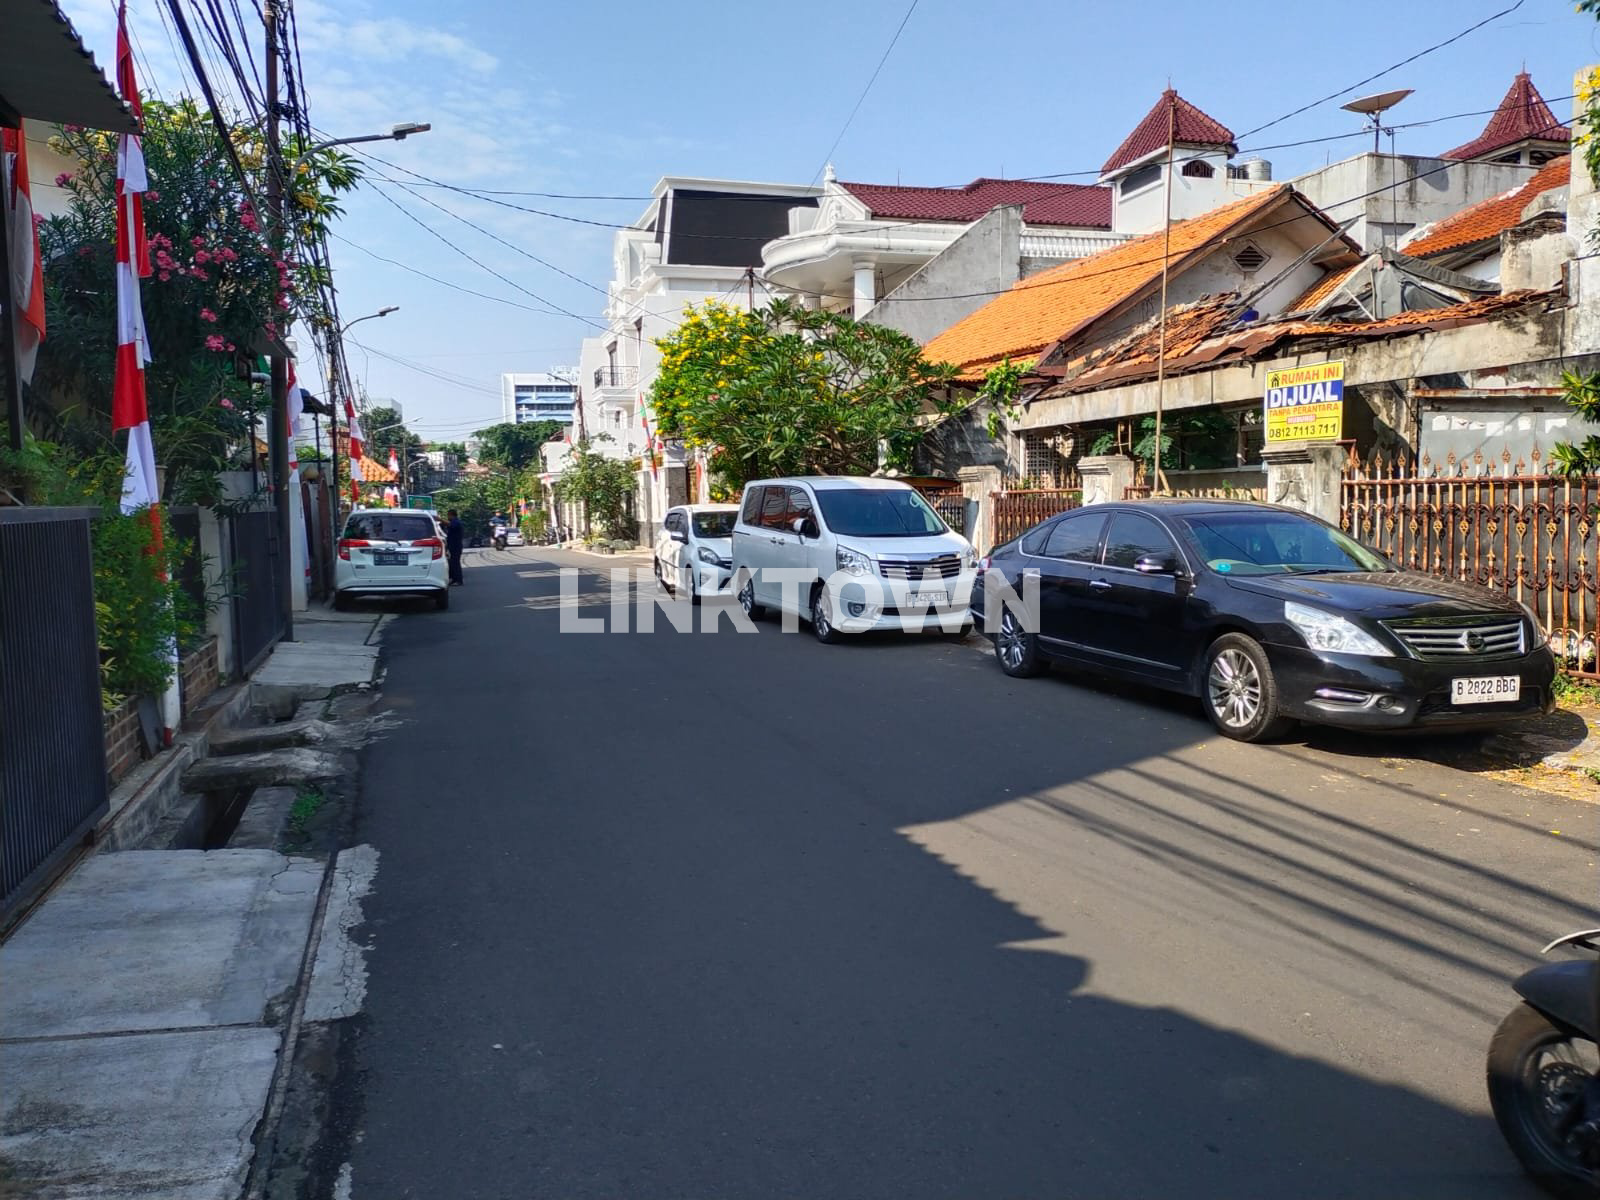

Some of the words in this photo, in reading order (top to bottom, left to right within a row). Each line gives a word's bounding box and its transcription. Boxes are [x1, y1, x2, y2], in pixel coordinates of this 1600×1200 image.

[1281, 370, 1319, 385] RUMAH
[1324, 367, 1339, 379] INI
[1270, 381, 1338, 408] DIJUAL
[1269, 408, 1291, 417] TANPA
[1293, 403, 1339, 415] PERANTARA
[1269, 427, 1291, 438] 0812
[1293, 425, 1315, 436] 7113
[1318, 423, 1337, 434] 711
[1457, 681, 1463, 695] B
[1468, 680, 1493, 694] 2822
[1496, 678, 1516, 693] BBG
